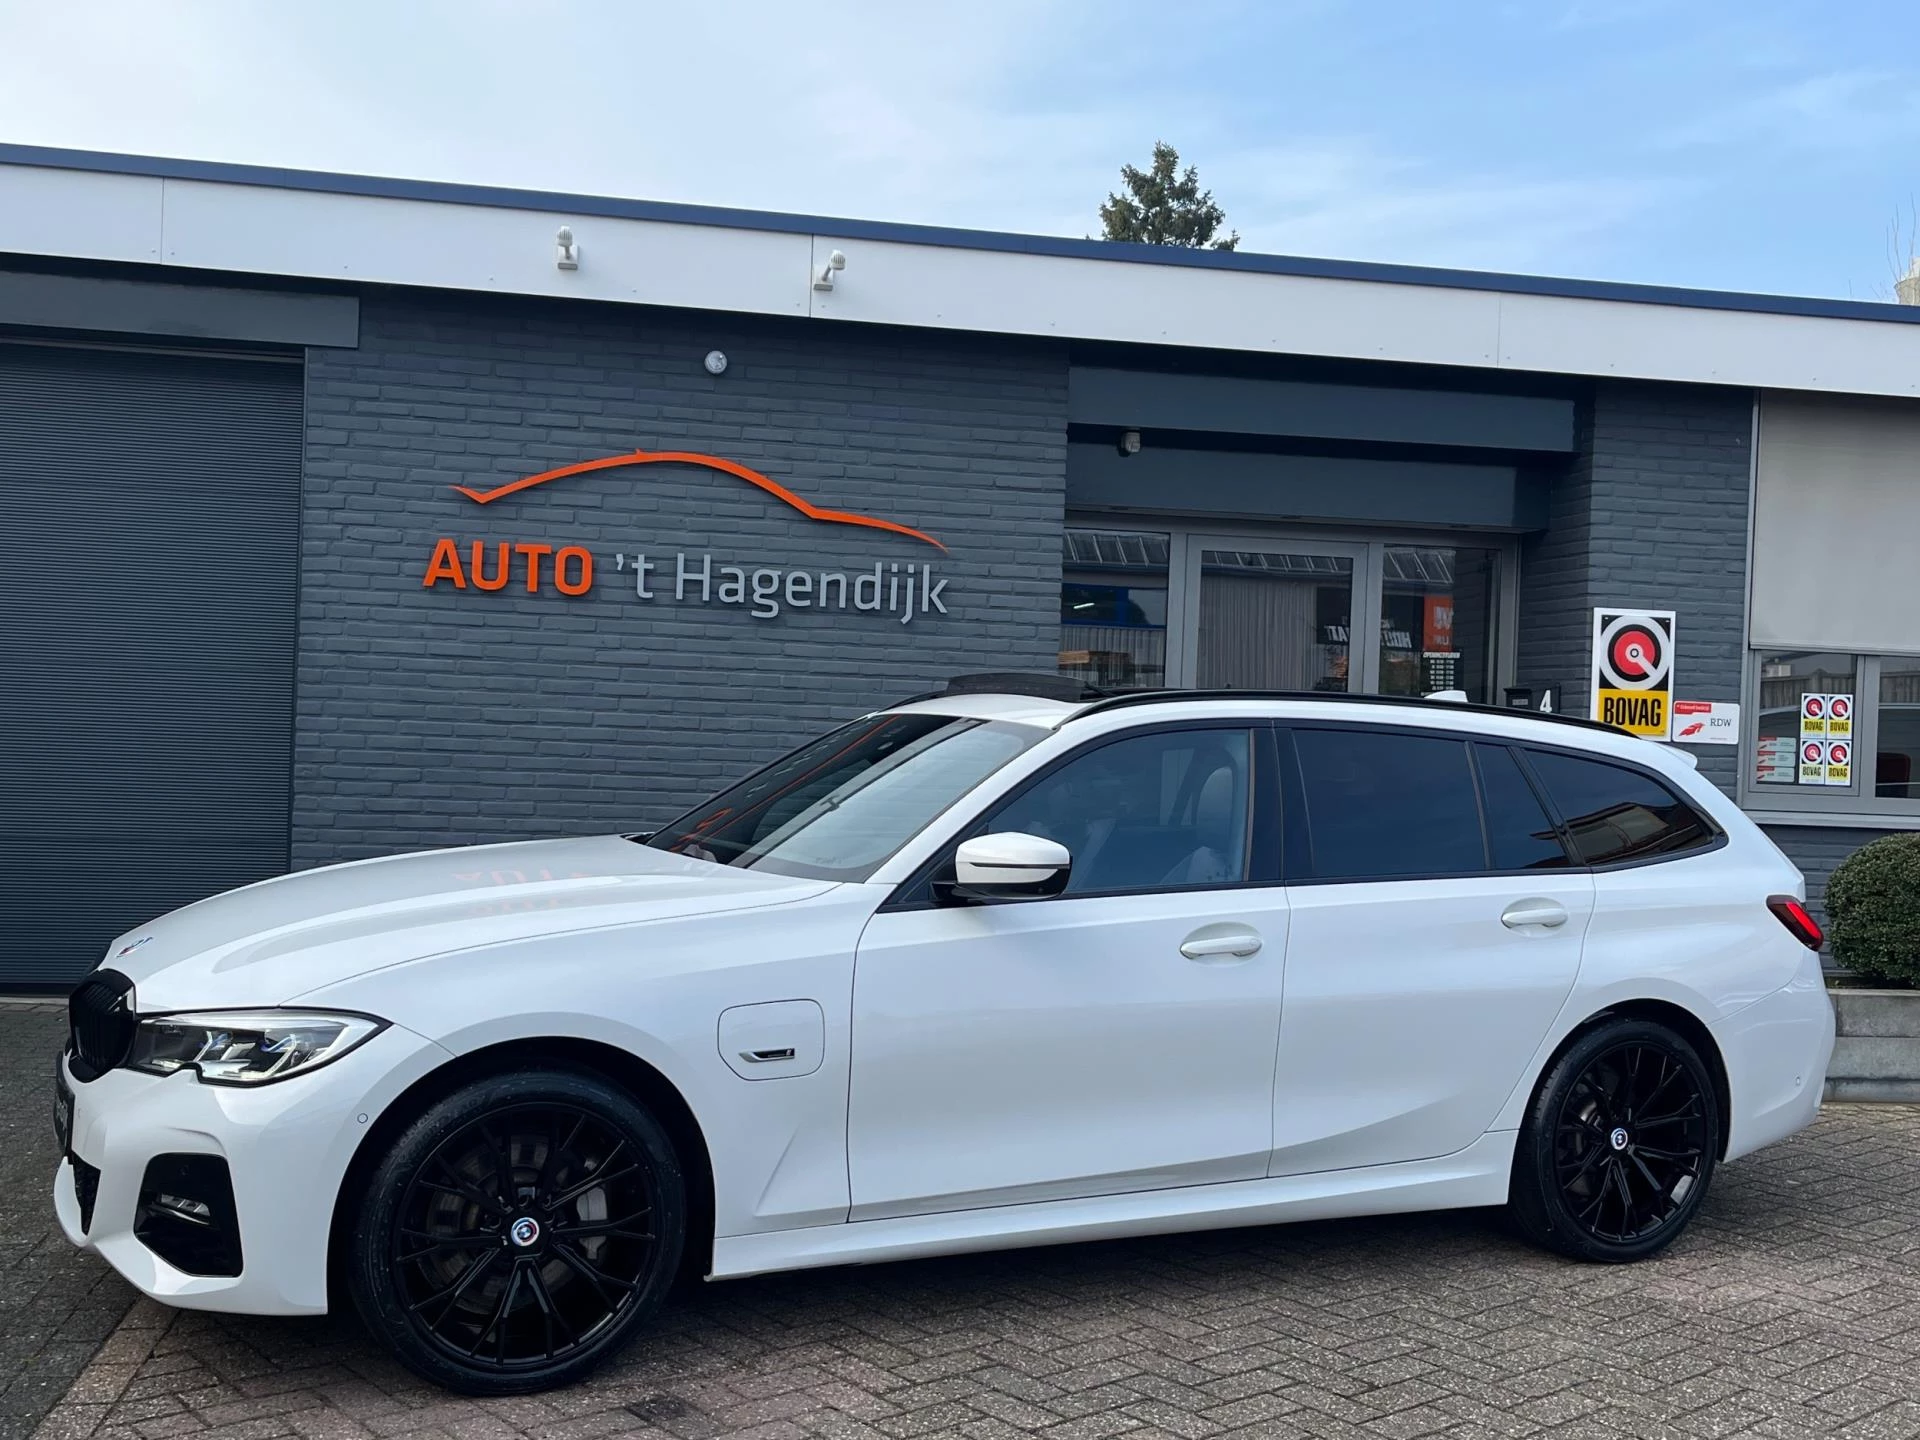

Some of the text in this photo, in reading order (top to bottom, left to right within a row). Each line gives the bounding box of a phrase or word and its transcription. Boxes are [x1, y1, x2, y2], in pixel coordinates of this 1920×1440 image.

[423, 538, 593, 596] AUTO
[675, 552, 949, 625] Hagendijk
[1539, 689, 1553, 713] 4
[1603, 696, 1662, 727] BOVAG
[1710, 718, 1732, 727] RDW
[1804, 720, 1824, 731] BOVAG
[1829, 721, 1849, 732] BOVAG
[1802, 766, 1821, 776] BOVAG
[1828, 767, 1847, 778] BOVAG
